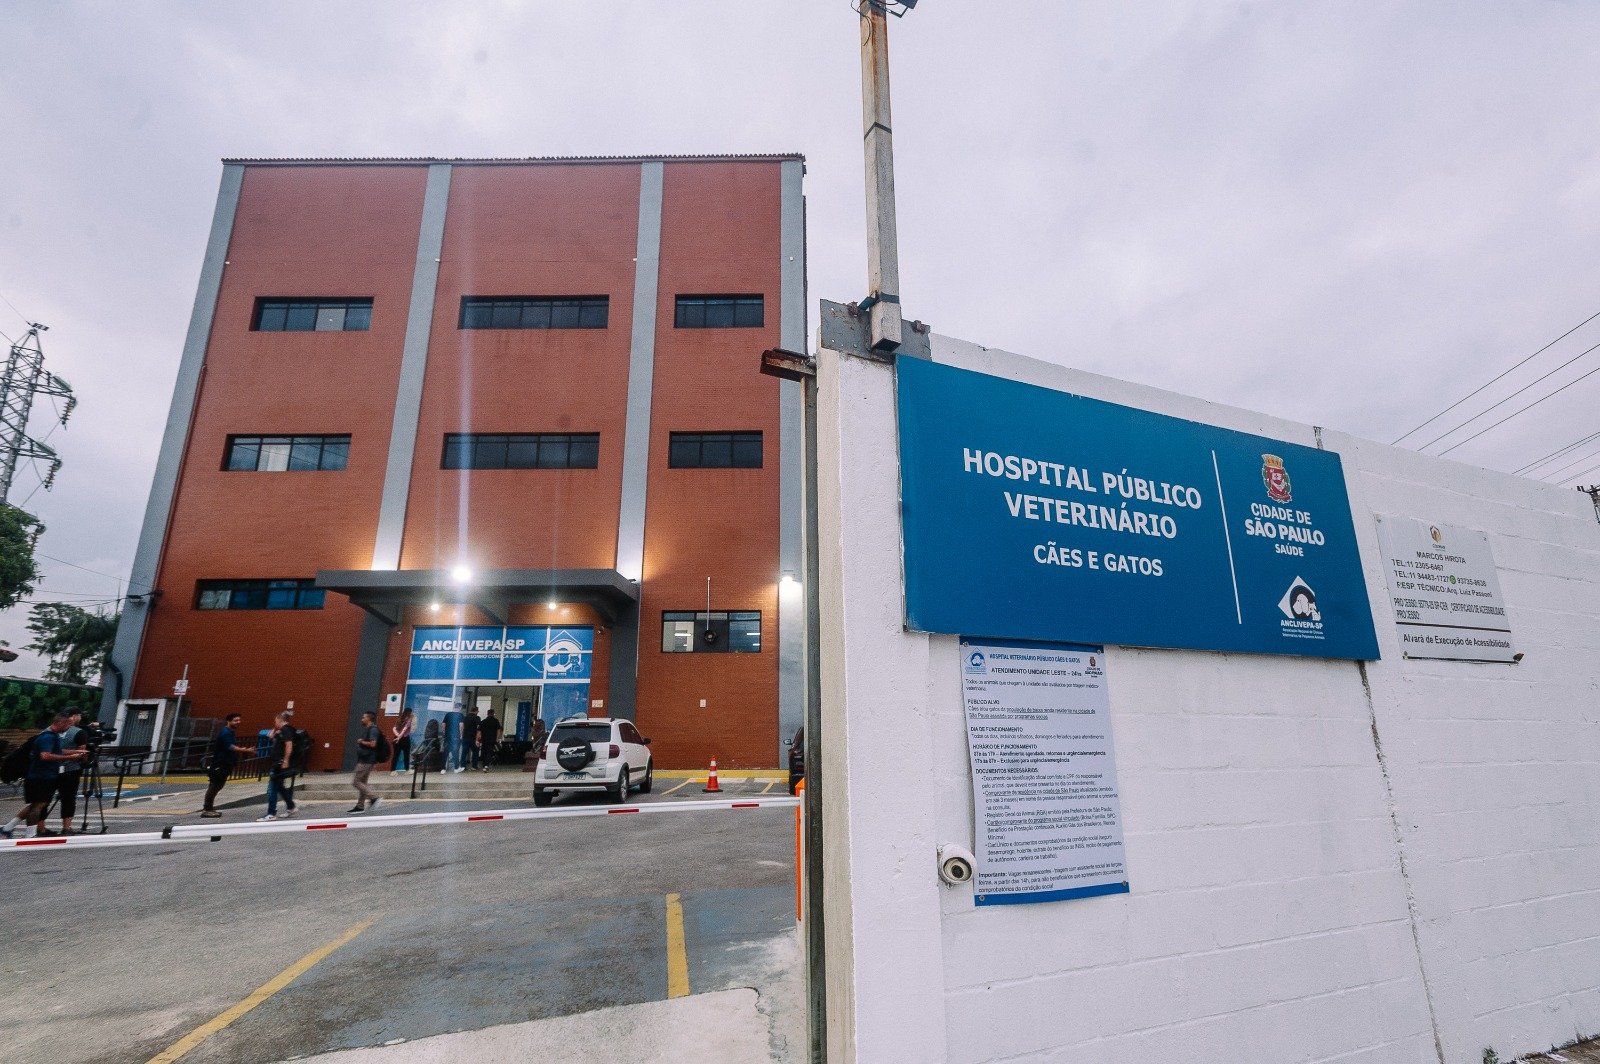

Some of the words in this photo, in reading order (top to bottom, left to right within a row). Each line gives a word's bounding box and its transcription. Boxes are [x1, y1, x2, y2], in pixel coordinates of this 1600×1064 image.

[963, 447, 1097, 492] HOSPITAL
[1102, 468, 1202, 510] PÚBLICO
[1004, 491, 1177, 539] VETERINÁRIO
[1250, 502, 1294, 522] CIDADE
[1296, 511, 1312, 525] DE
[1244, 517, 1276, 539] SÃO
[1278, 524, 1325, 546] PAULO
[1034, 541, 1083, 568] CÃES
[1087, 550, 1100, 570] E
[1103, 553, 1164, 578] GATOS
[1274, 543, 1304, 556] SAÚDE
[1416, 551, 1444, 561] MARCOS
[1444, 555, 1466, 564] HIROTA
[1280, 619, 1324, 630] ANCLIVEPA-SP
[1404, 633, 1424, 644] Alvará
[1426, 635, 1434, 644] de
[1434, 635, 1464, 647] Execução
[1464, 638, 1472, 646] de
[1473, 638, 1510, 648] Acessibilidade
